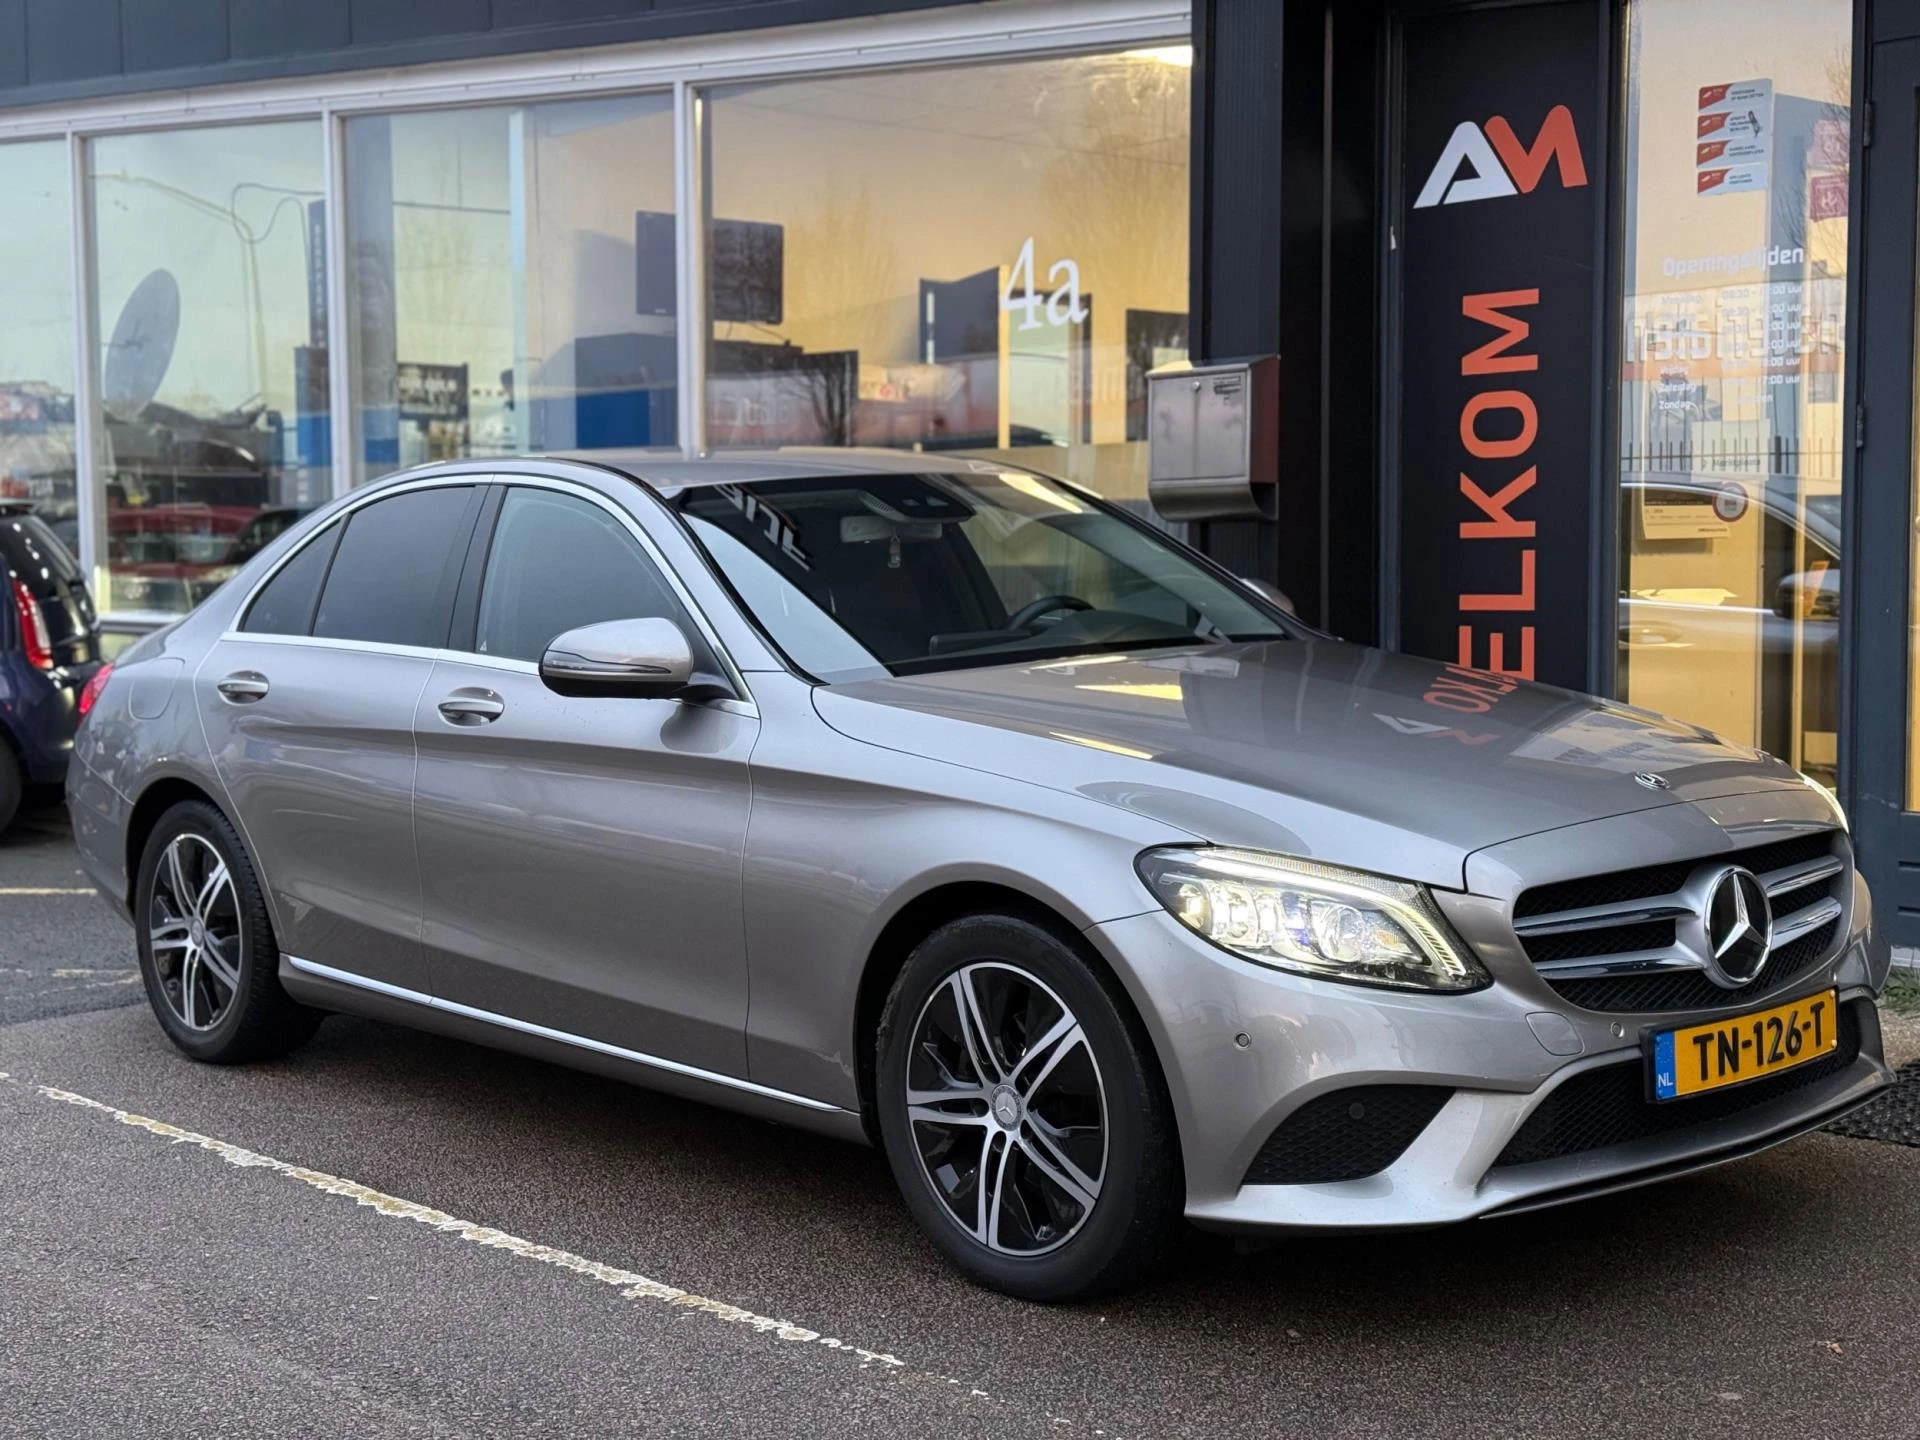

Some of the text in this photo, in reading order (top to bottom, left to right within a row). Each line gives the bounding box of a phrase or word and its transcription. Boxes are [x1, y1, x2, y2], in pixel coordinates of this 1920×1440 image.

[1413, 105, 1588, 209] AM
[1000, 237, 1089, 331] 4a
[1663, 246, 1804, 279] Openingstijden
[1659, 400, 1690, 411] Zondag
[1693, 1001, 1826, 1082] TN-126-T
[1657, 1073, 1674, 1088] NL
